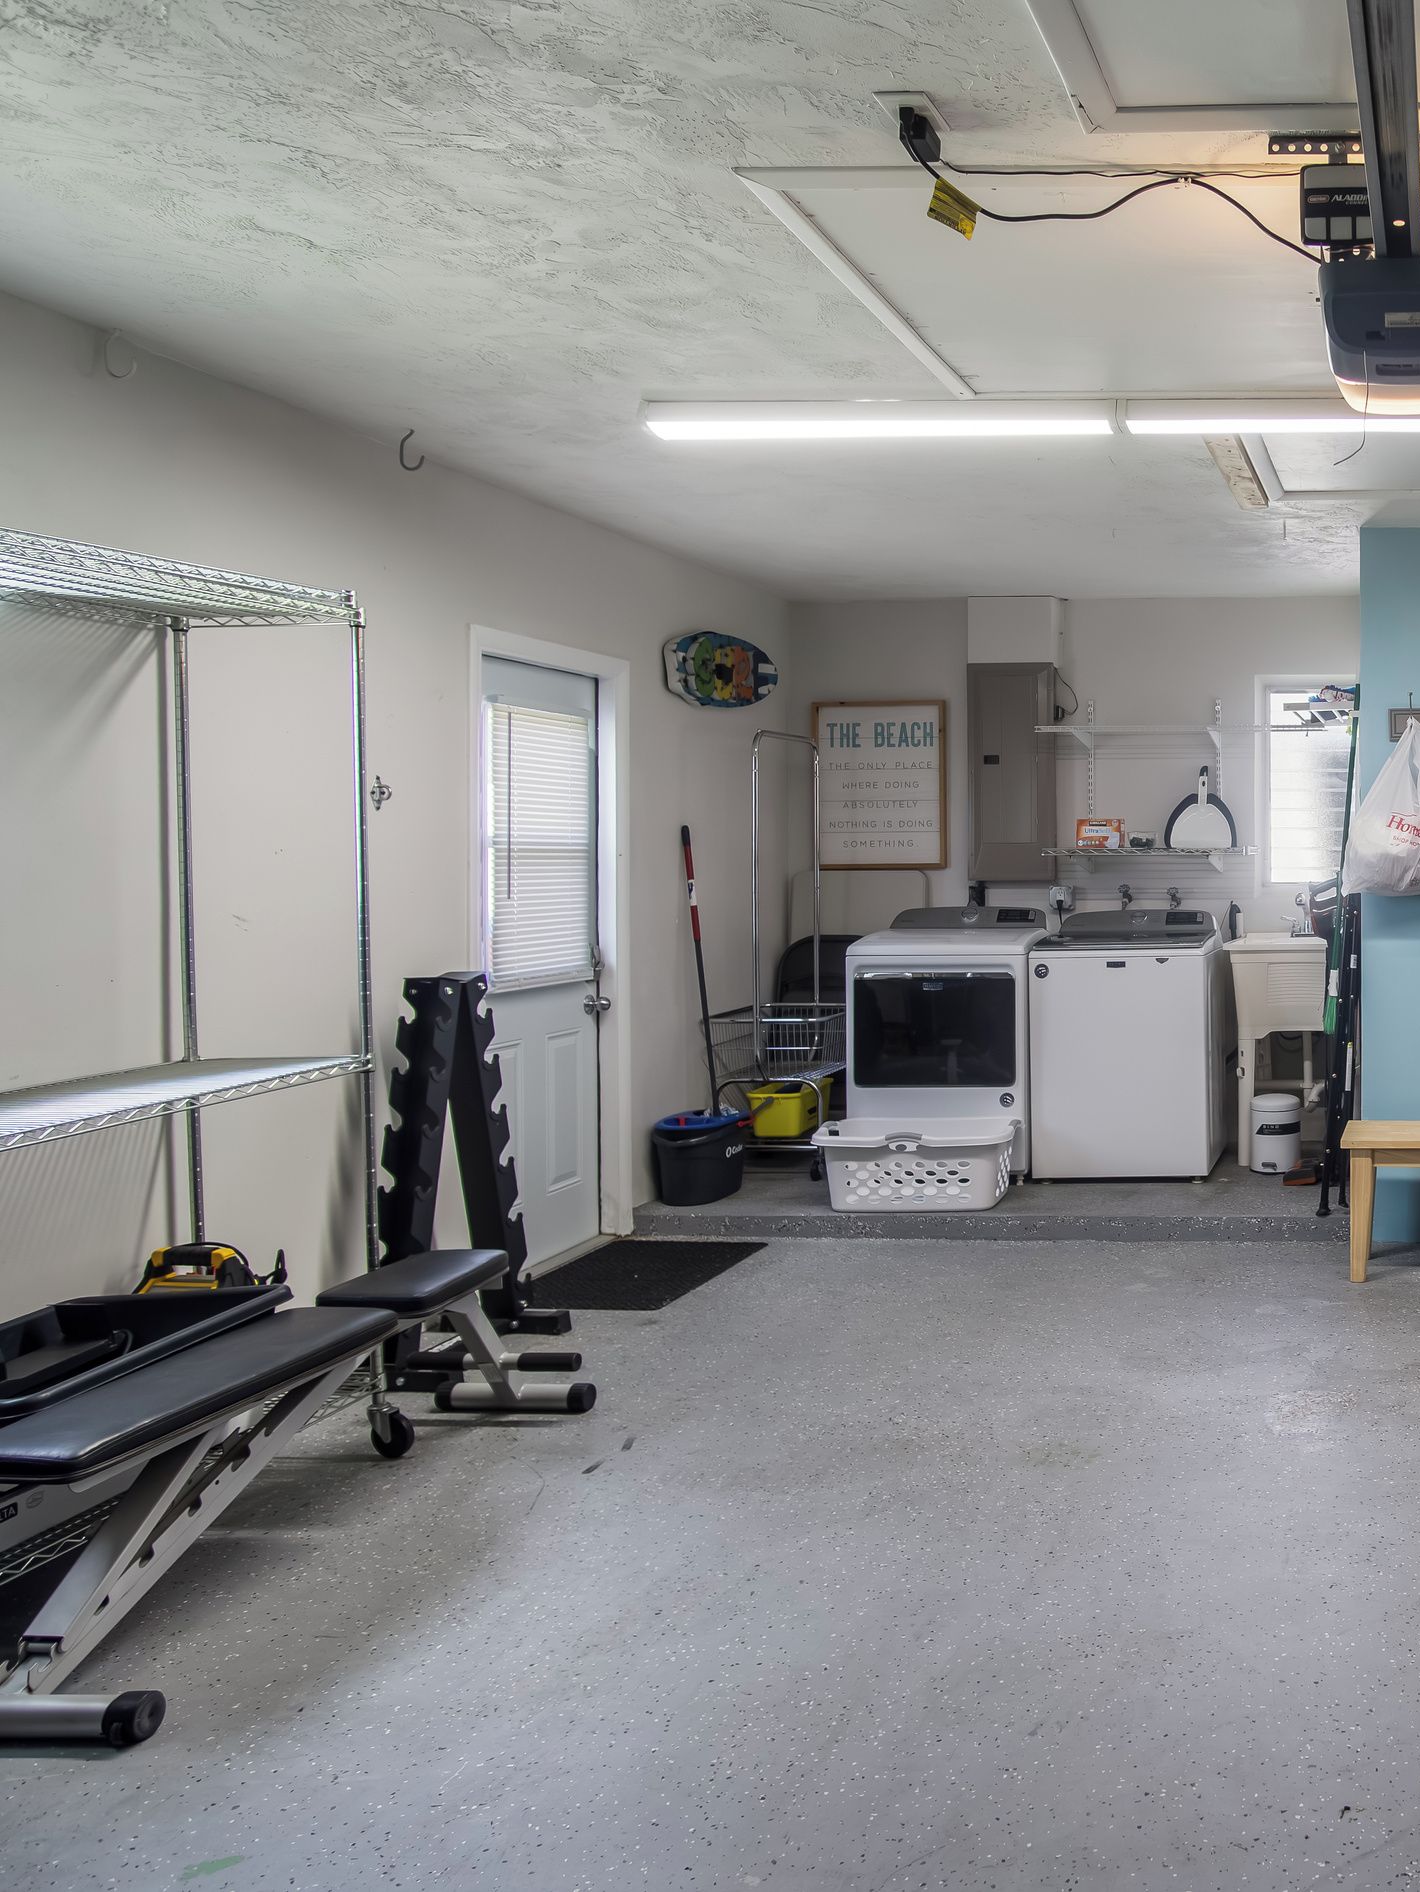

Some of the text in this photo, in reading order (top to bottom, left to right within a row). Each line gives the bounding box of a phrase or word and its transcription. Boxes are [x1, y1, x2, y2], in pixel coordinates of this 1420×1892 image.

[826, 721, 934, 748] THE BEACH
[829, 760, 933, 770] THE ONLY PLACE
[842, 780, 920, 790] WHERE DOING
[842, 800, 919, 809] ABSOLUTELY
[829, 819, 933, 829] NOTHING IS DOING
